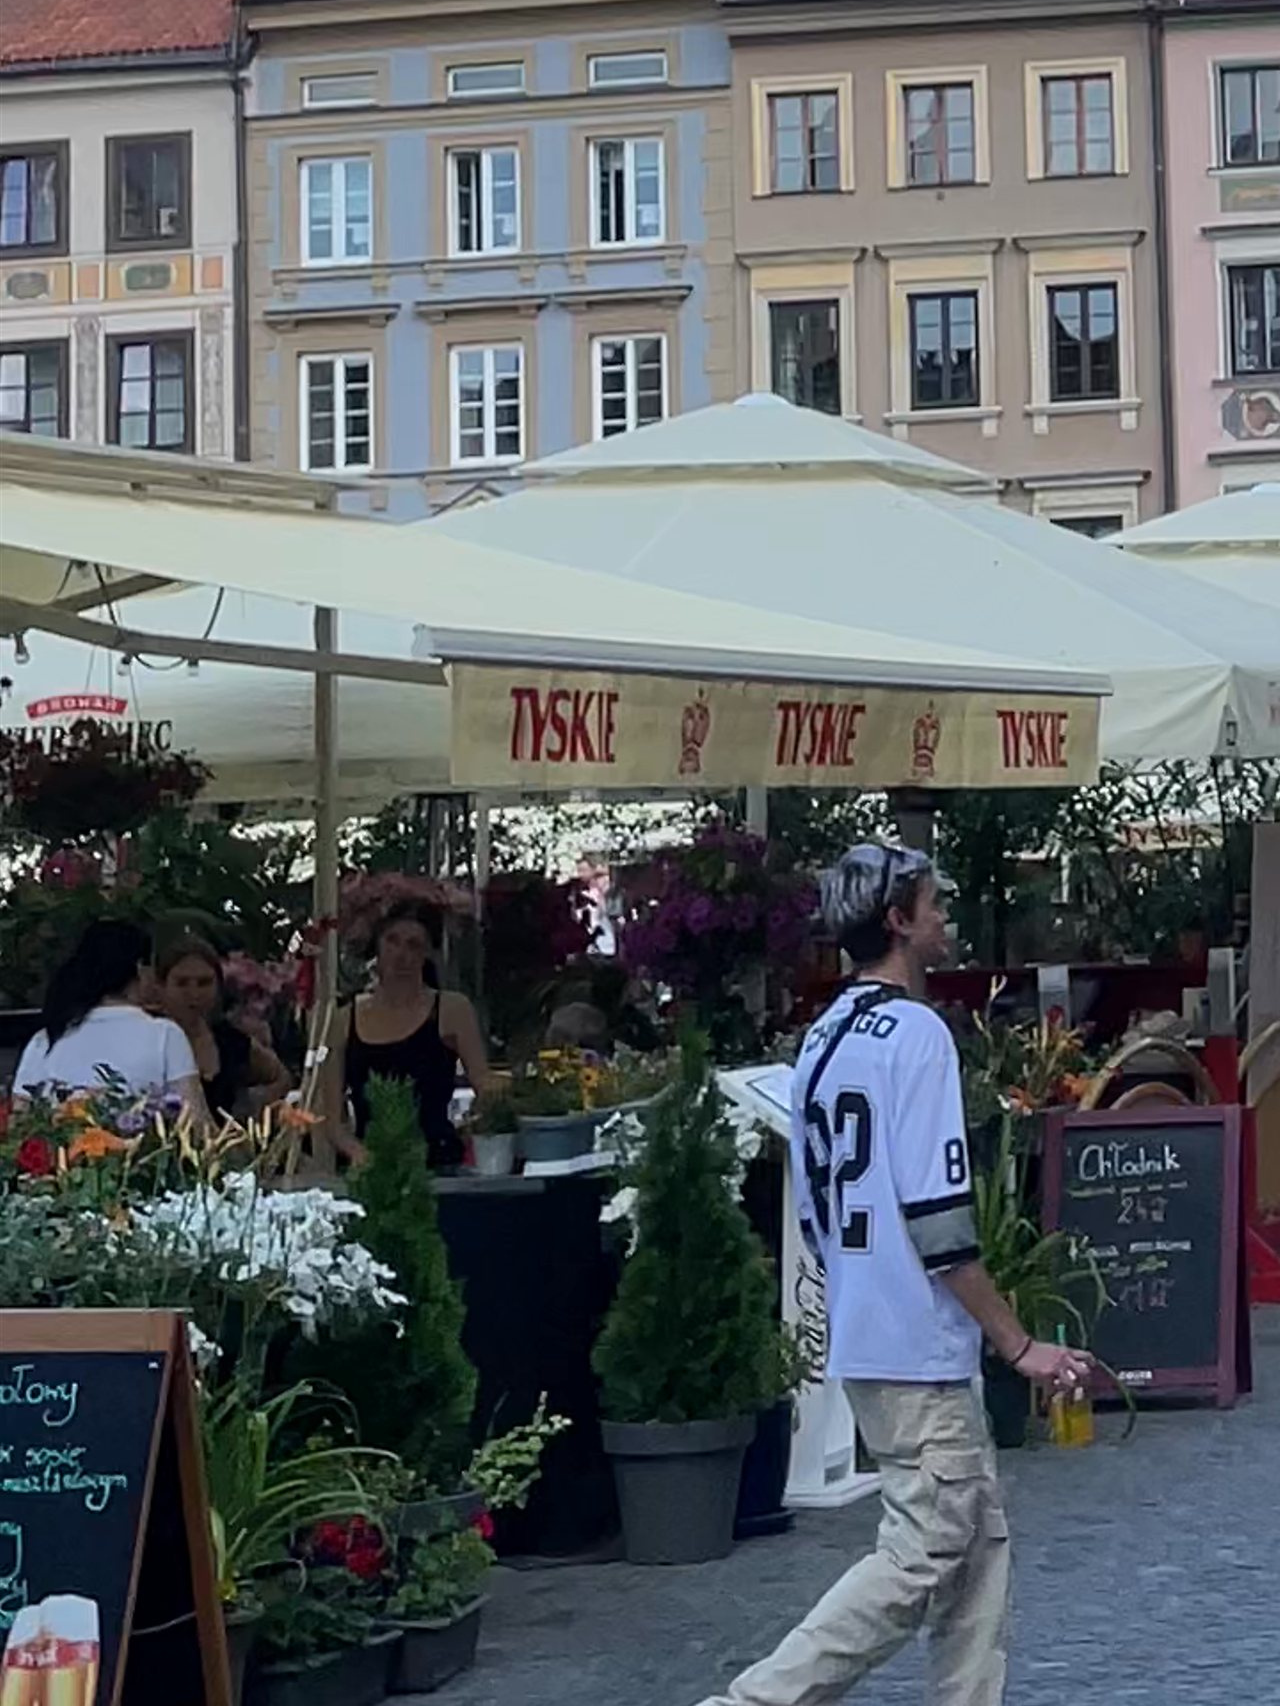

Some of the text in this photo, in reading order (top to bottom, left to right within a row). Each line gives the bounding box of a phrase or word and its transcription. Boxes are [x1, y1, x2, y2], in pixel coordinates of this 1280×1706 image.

[510, 687, 619, 763] TYSKIE
[776, 700, 866, 767] TYSKIE
[996, 709, 1068, 768] TYSKIE
